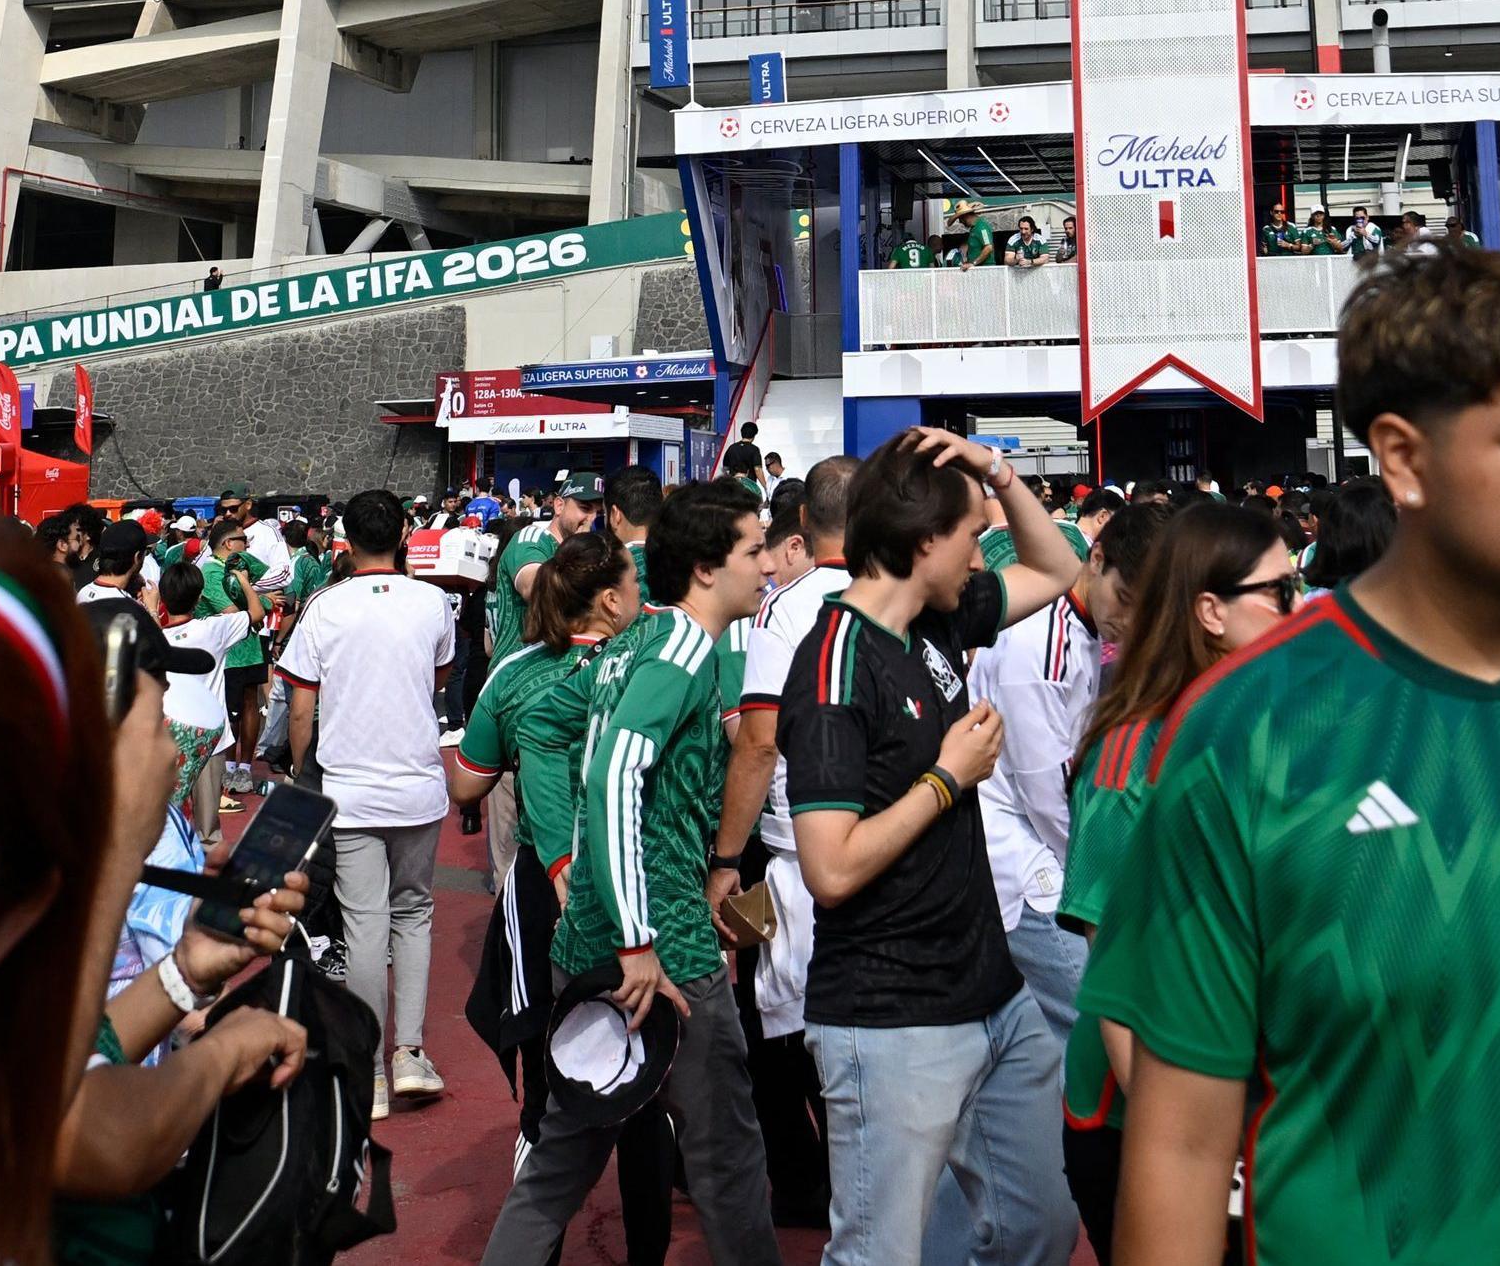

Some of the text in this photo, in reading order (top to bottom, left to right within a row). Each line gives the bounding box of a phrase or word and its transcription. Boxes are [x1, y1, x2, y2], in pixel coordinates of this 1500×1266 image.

[663, 39, 675, 82] Michelob
[762, 62, 770, 98] ULTRA
[1327, 91, 1406, 107] CERVEZA
[1412, 89, 1473, 104] LIGERA
[751, 109, 978, 135] CERVEZA LIGERA SUPERIOR
[1097, 133, 1228, 167] Michelob
[1119, 166, 1216, 191] ULTRA
[909, 249, 920, 267] 9
[51, 294, 222, 354] MUNDIAL
[231, 282, 280, 321] DE
[288, 274, 339, 313] LA
[347, 261, 433, 304] FIFA
[442, 233, 587, 286] 2026
[537, 370, 573, 383] LIGERA
[575, 367, 628, 380] SUPERIOR
[655, 364, 705, 378] Michelob
[490, 420, 587, 434] Michelob ULTRA
